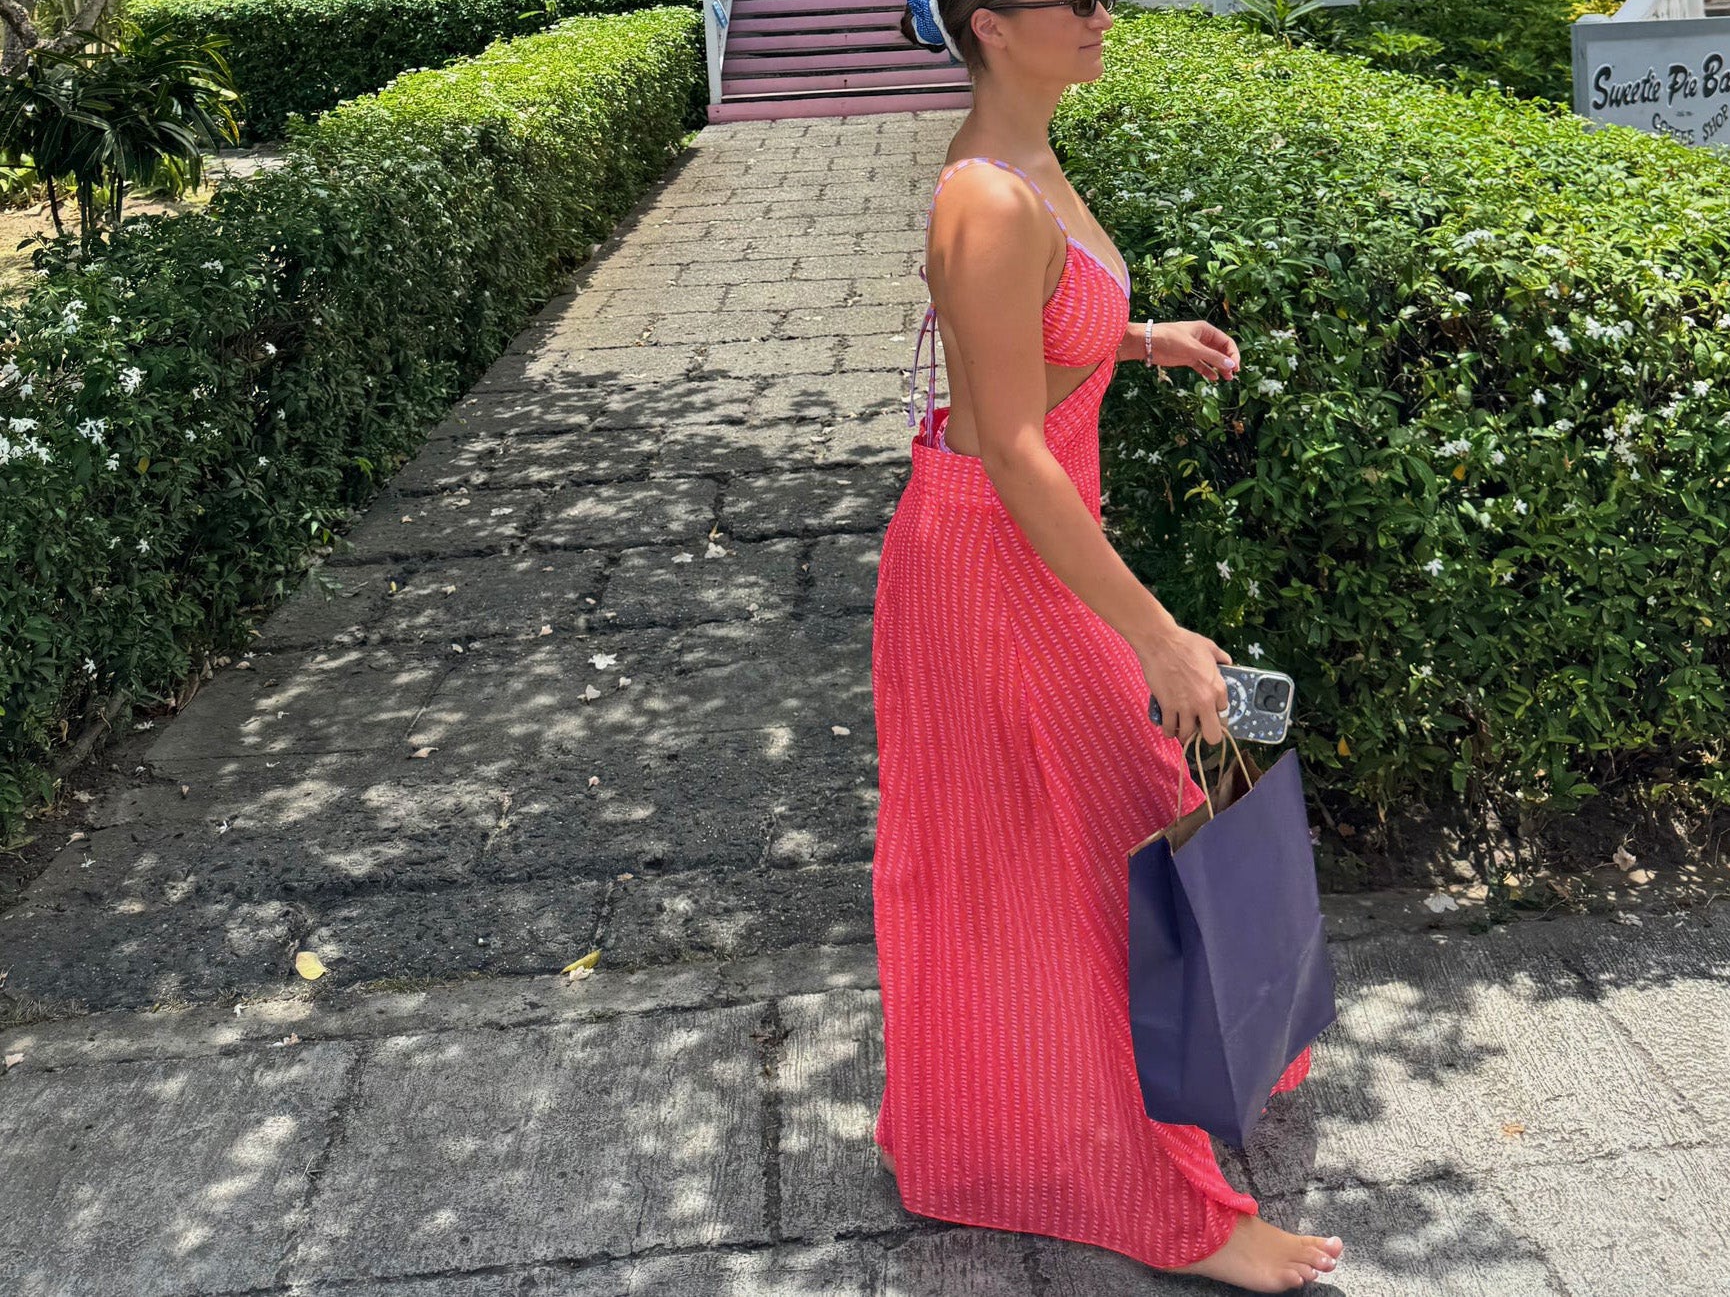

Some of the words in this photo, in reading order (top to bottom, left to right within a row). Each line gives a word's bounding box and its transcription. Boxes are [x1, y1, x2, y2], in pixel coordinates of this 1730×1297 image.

[1592, 64, 1661, 111] Sweetie
[1667, 63, 1698, 107] Pie
[1702, 104, 1729, 142] SHOP
